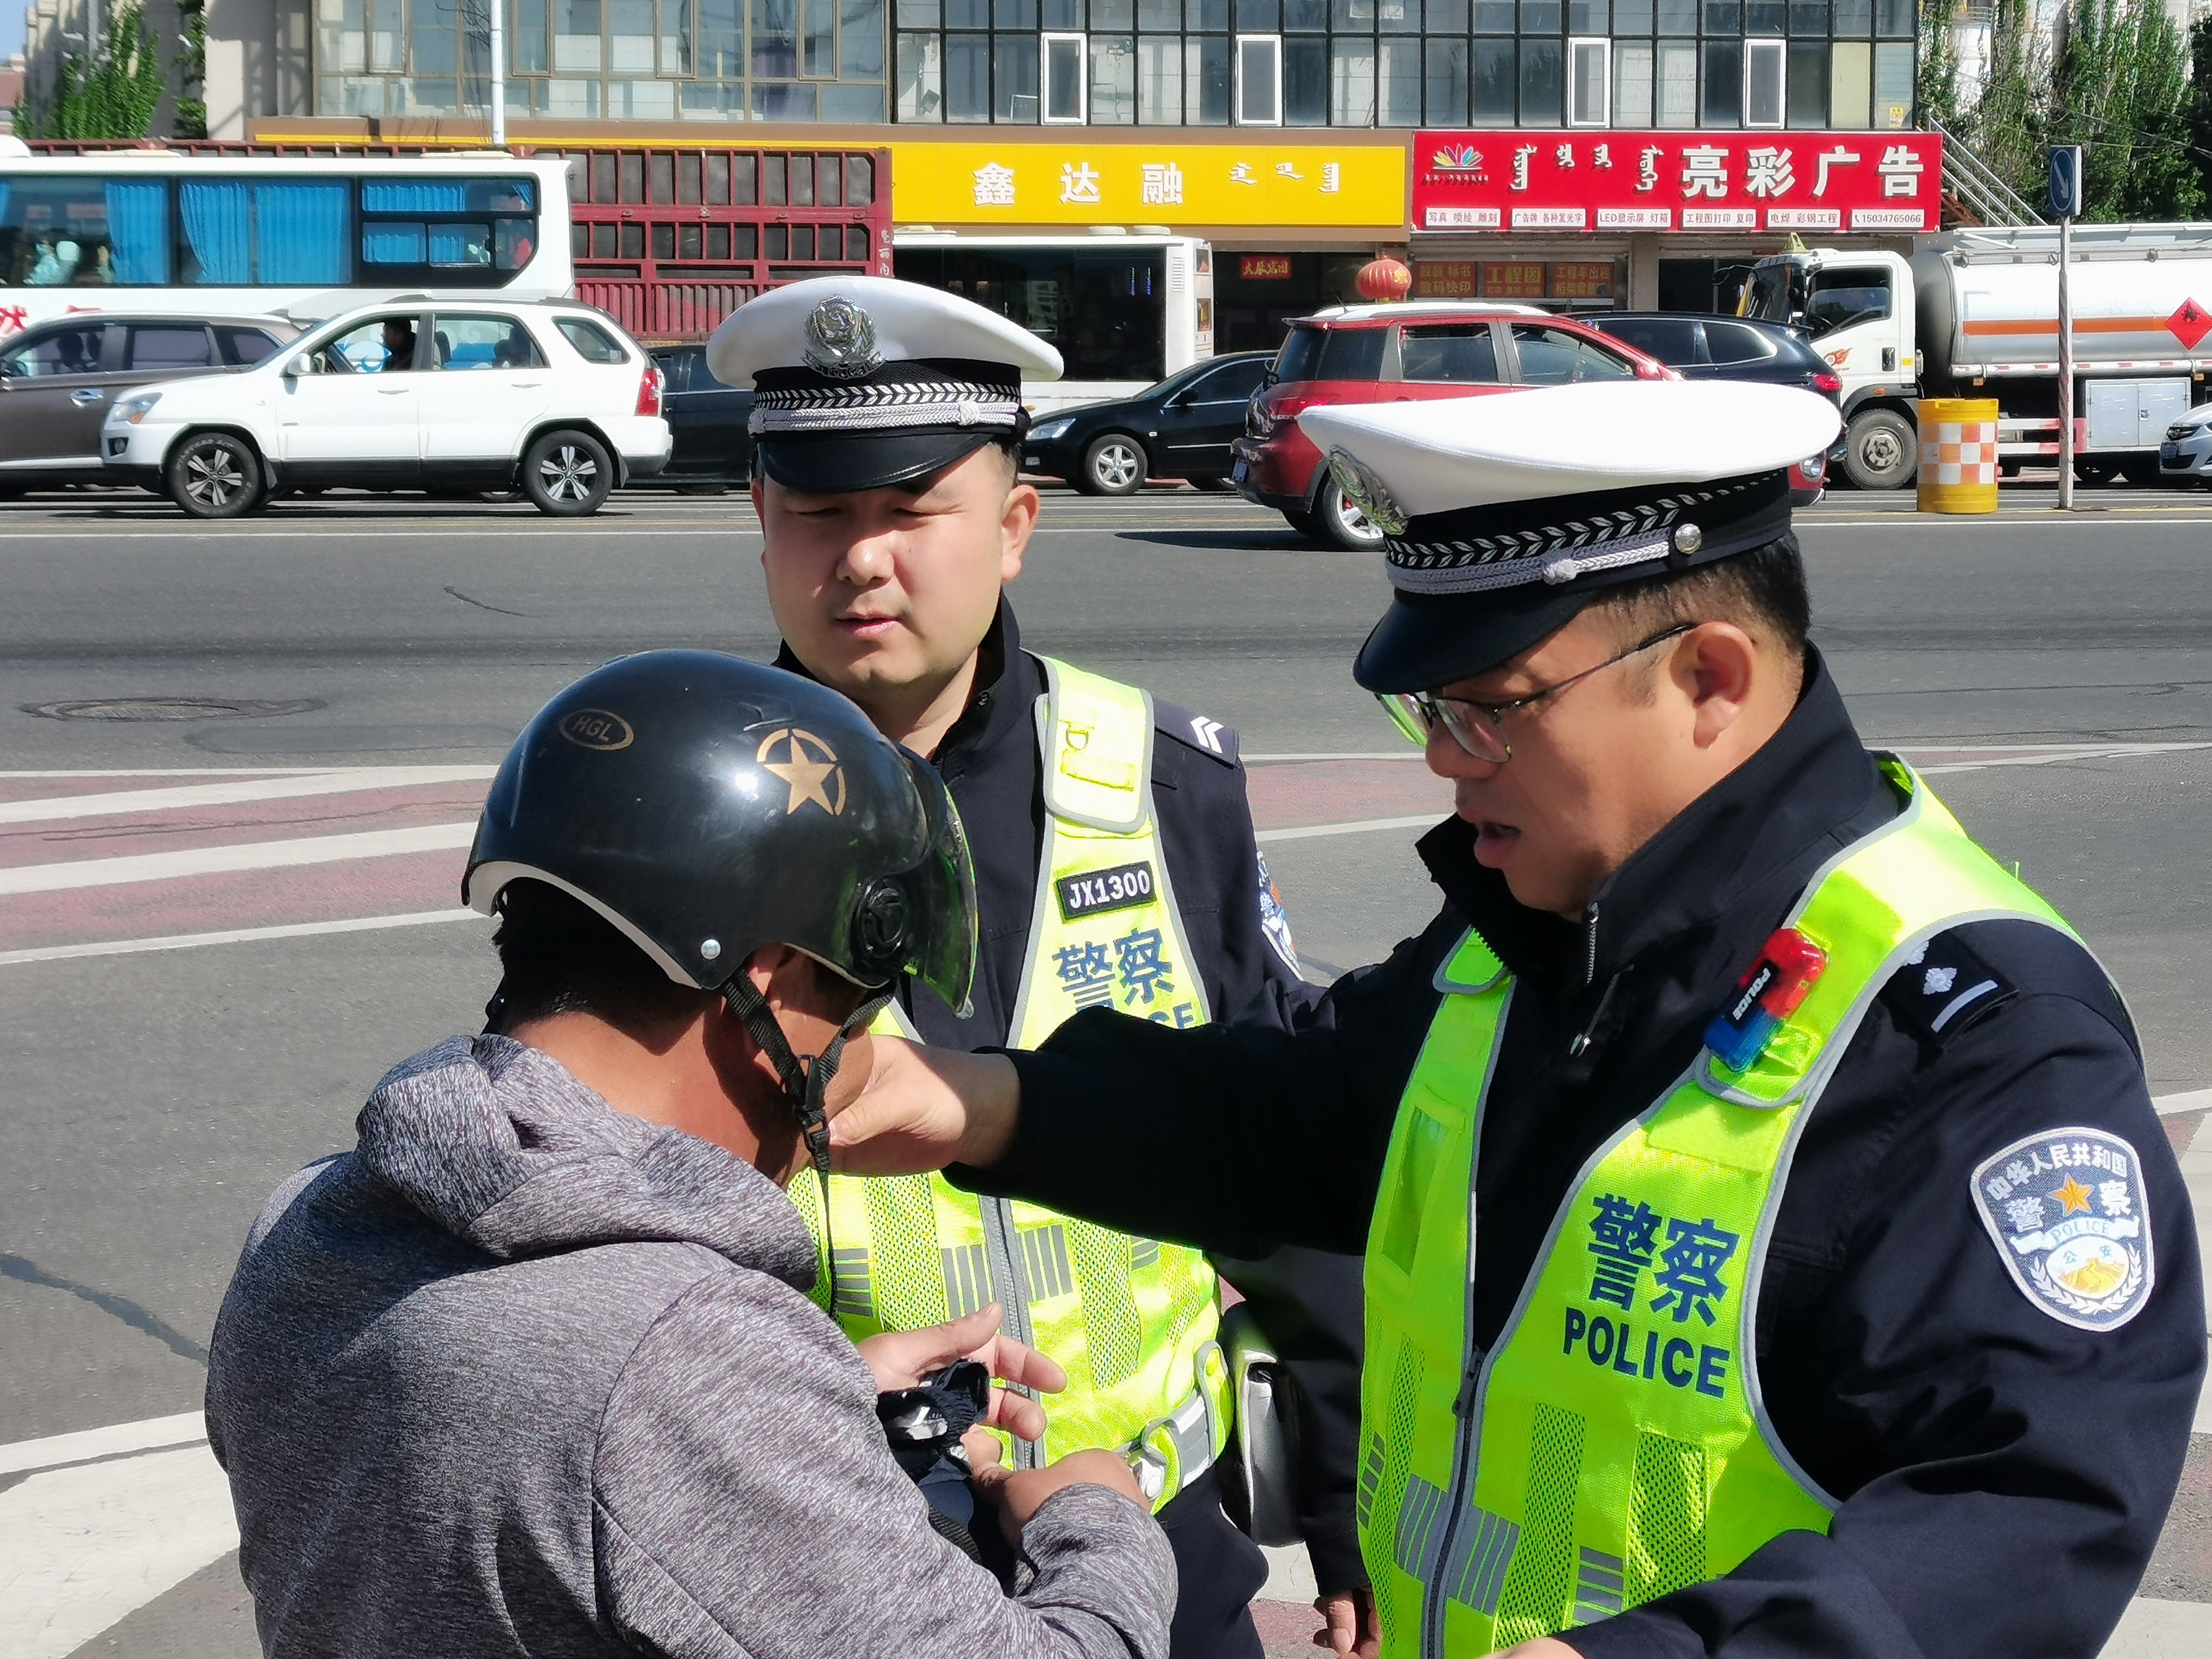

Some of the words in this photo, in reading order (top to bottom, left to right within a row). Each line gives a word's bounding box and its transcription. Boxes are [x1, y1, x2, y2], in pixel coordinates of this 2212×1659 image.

[972, 162, 1183, 205] 鑫达融
[1682, 144, 1924, 198] 亮彩广告
[1428, 212, 1448, 223] 写真
[1600, 213, 1645, 223] LED显示屏
[1649, 213, 1668, 224] 灯箱
[1685, 213, 1731, 224] 工程图打印
[1736, 213, 1754, 224] 复印
[1796, 213, 1838, 224] 彩钢工程
[1862, 214, 1922, 223] 15034765066
[571, 715, 612, 742] HGL
[1070, 869, 1150, 909] JX1300
[1052, 928, 1175, 1012] 警察
[1732, 967, 1771, 1021] POLICE
[1986, 1142, 2128, 1201] 中华人民共和国
[2050, 1219, 2111, 1243] POLICE
[1587, 1193, 1740, 1326] 警察
[1563, 1306, 1731, 1399] POLICE
